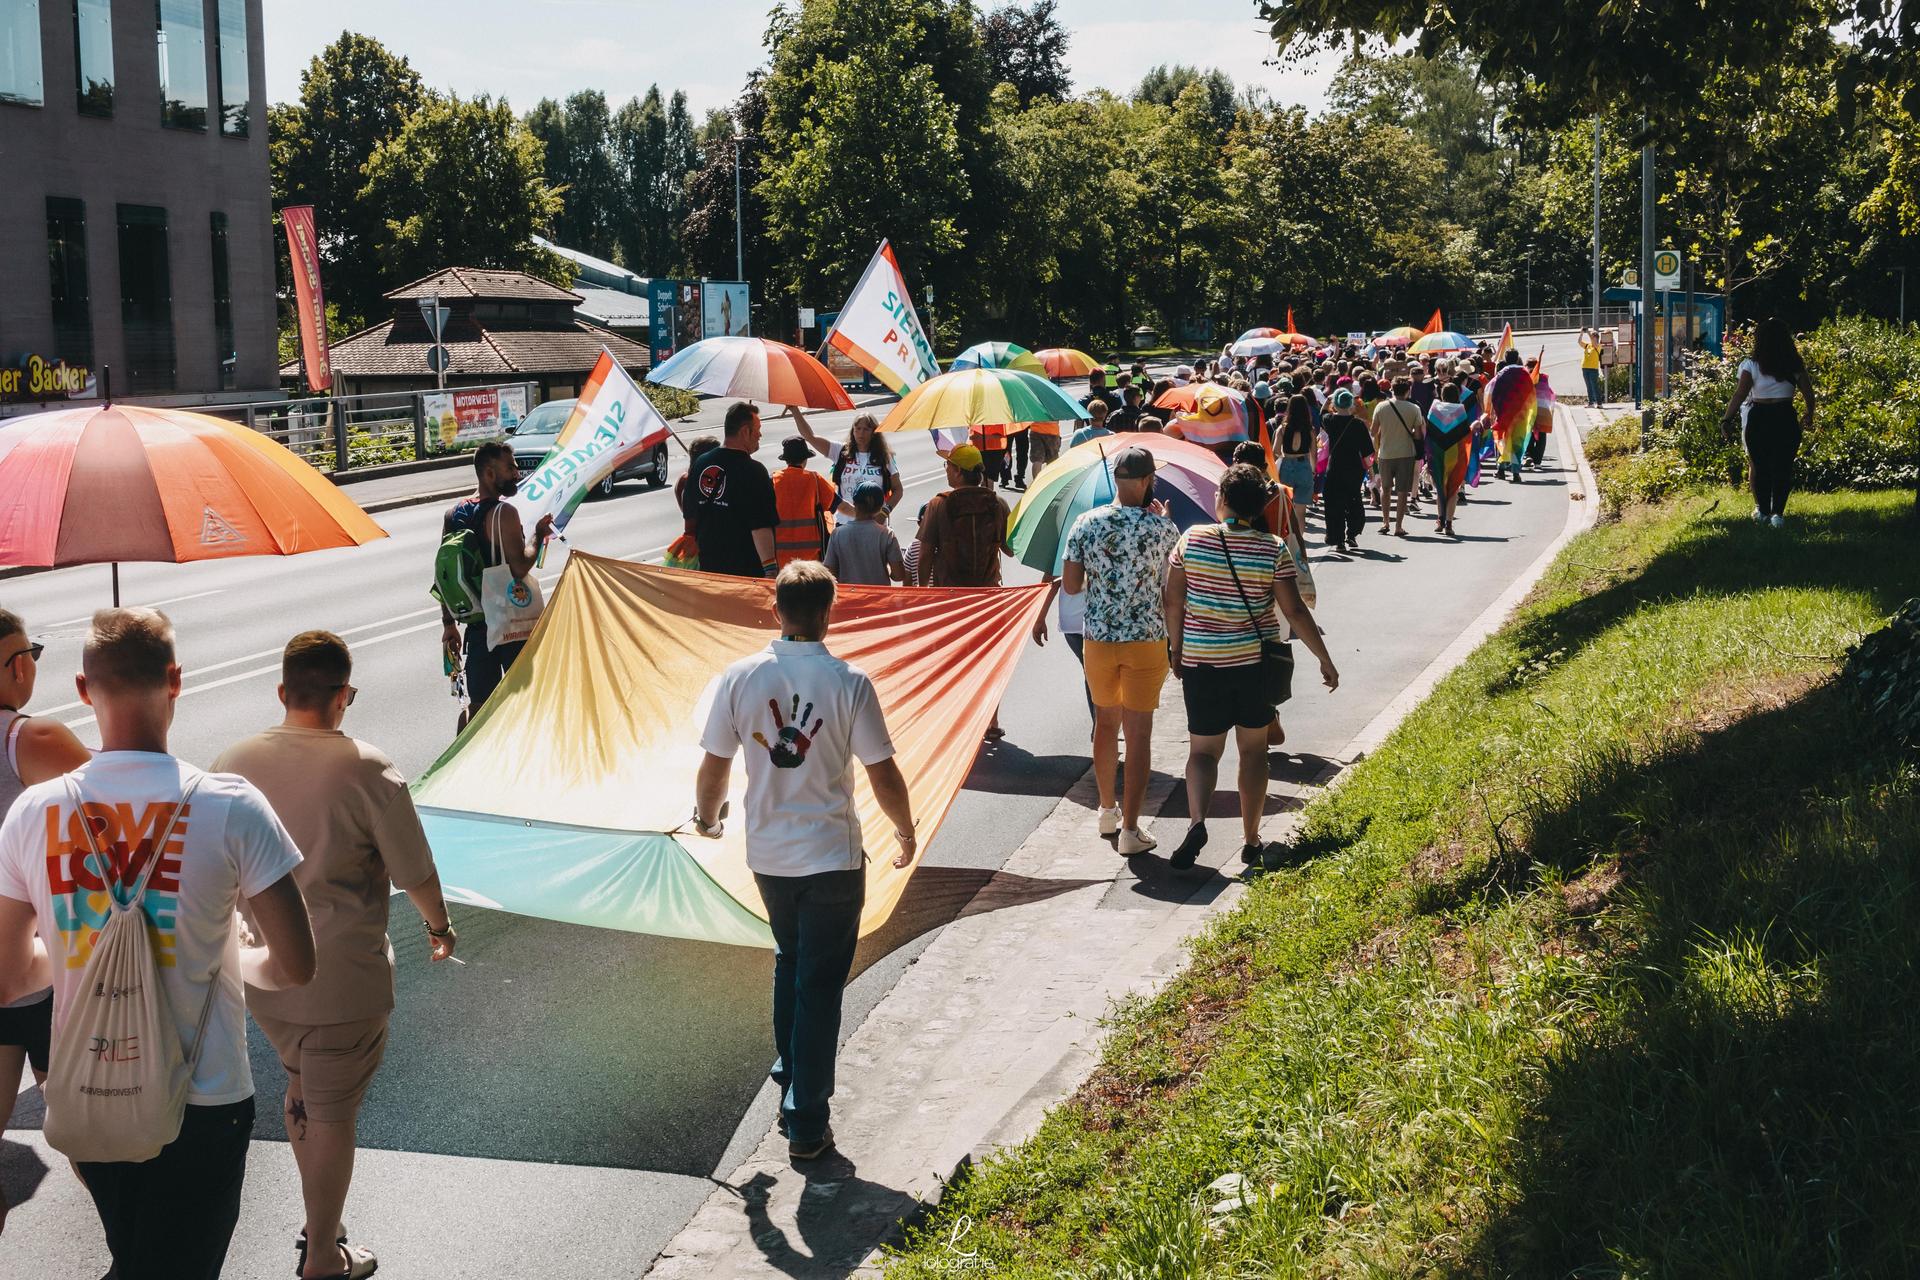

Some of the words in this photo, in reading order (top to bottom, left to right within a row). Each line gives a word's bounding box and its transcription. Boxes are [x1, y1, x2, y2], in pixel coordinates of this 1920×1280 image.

[0, 368, 22, 393] er
[28, 355, 88, 393] Bäcker
[46, 801, 191, 858] LOVE
[46, 838, 181, 896] LOVE
